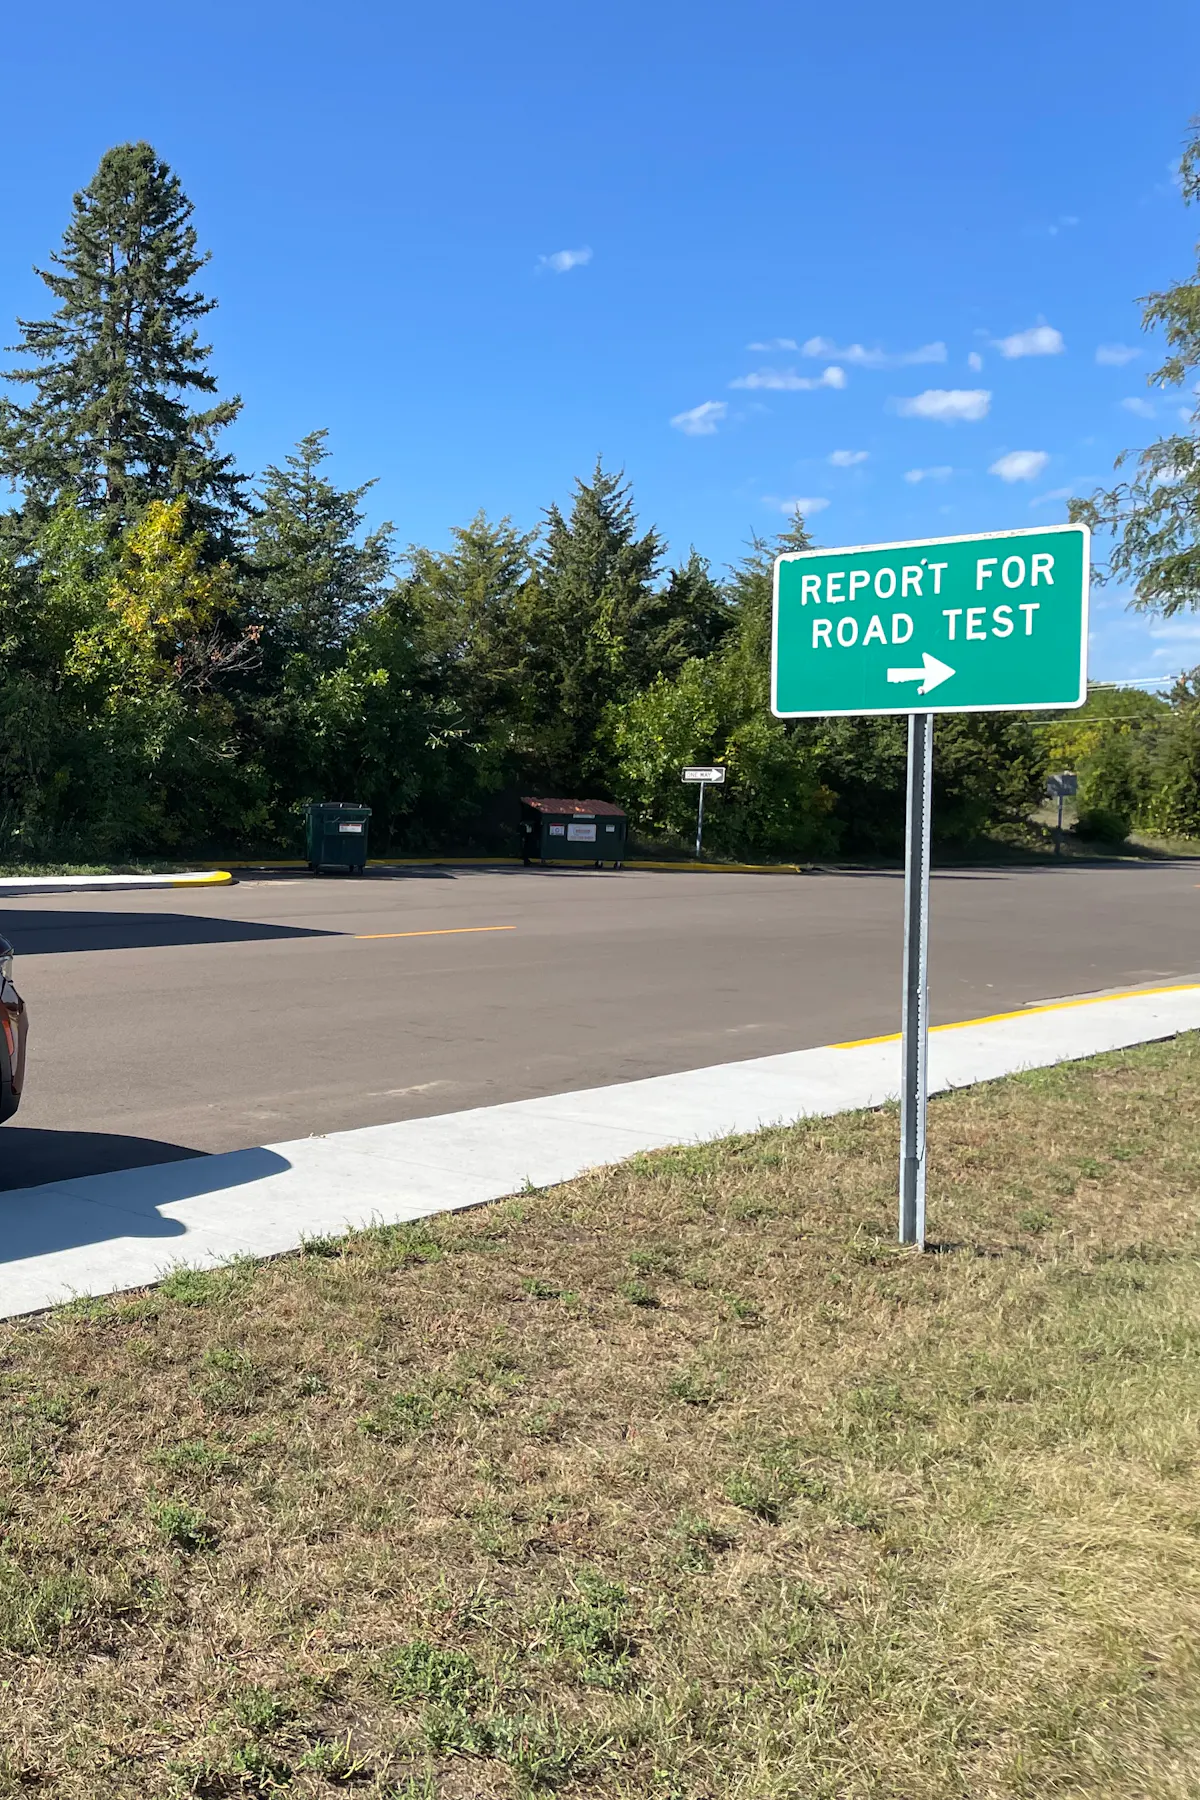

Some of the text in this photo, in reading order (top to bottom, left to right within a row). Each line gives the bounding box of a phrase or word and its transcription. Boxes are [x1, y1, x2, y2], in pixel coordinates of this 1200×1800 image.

[801, 553, 1055, 606] REPORT FOR
[812, 603, 1041, 649] ROAD TEST
